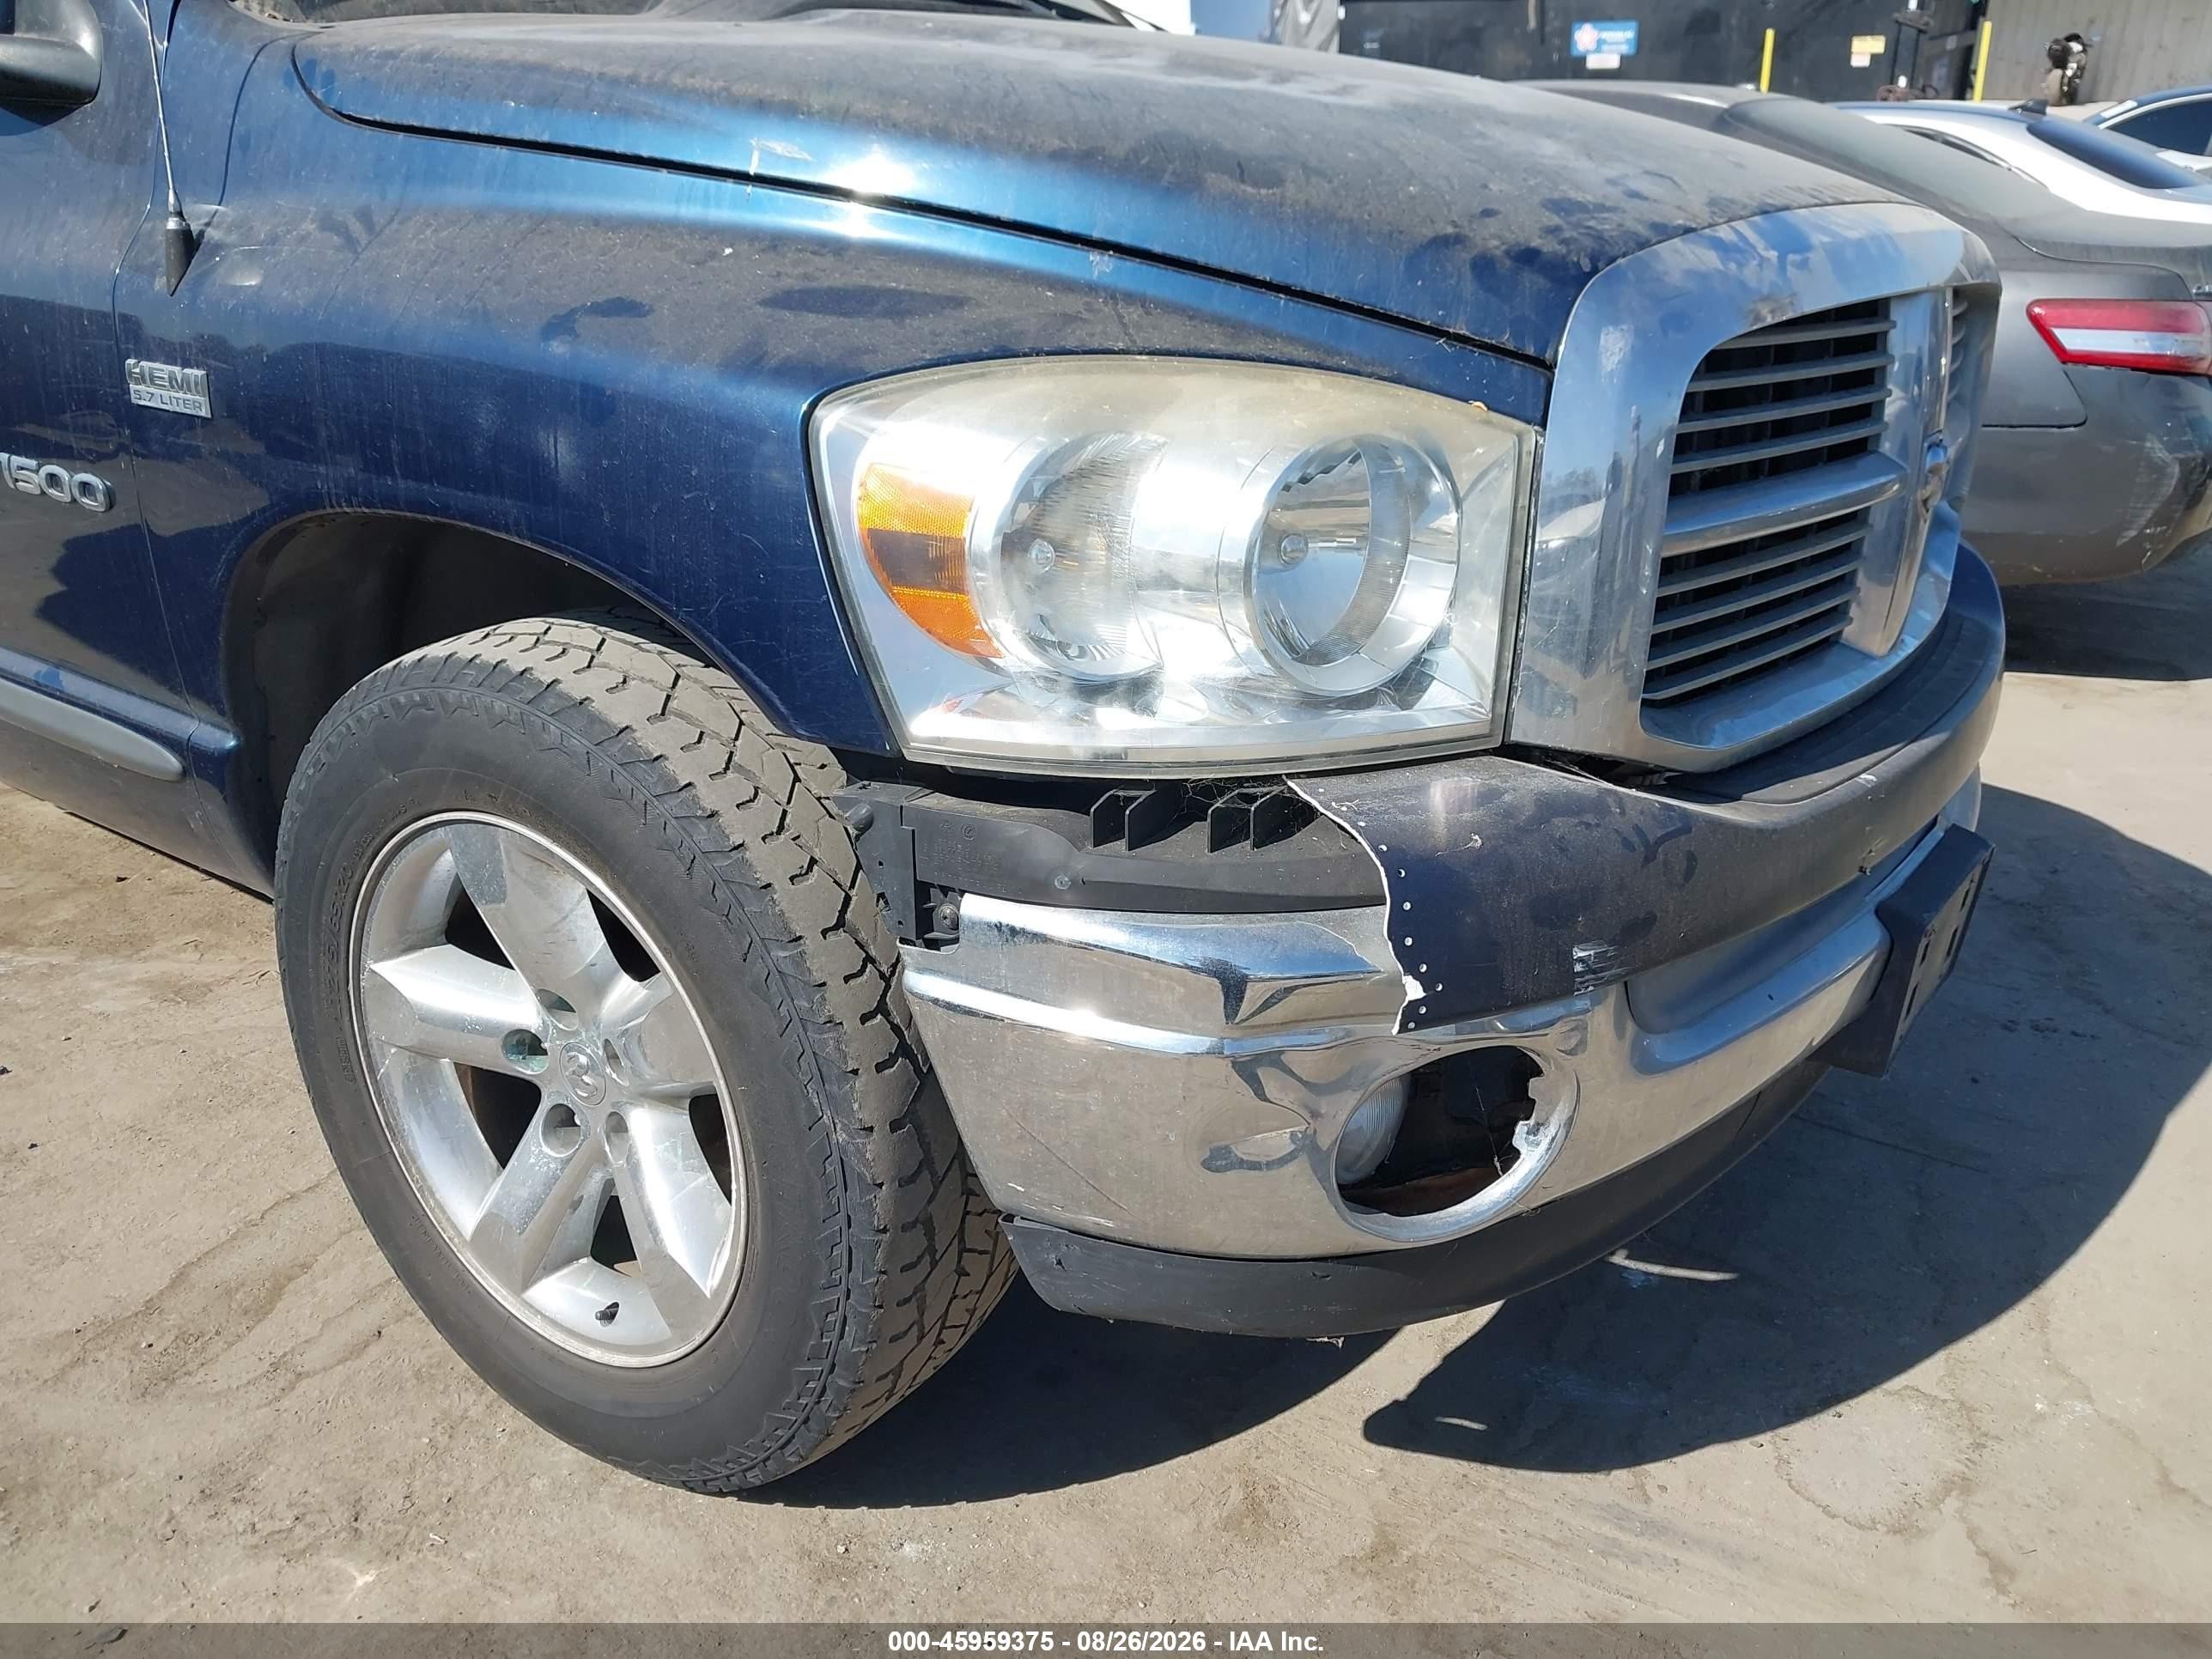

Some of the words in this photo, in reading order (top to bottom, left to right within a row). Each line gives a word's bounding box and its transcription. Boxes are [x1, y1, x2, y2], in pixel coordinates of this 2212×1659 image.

[125, 359, 207, 398] HEMI
[133, 389, 155, 402] 5.7
[159, 393, 203, 411] LITER
[0, 452, 110, 512] 1500
